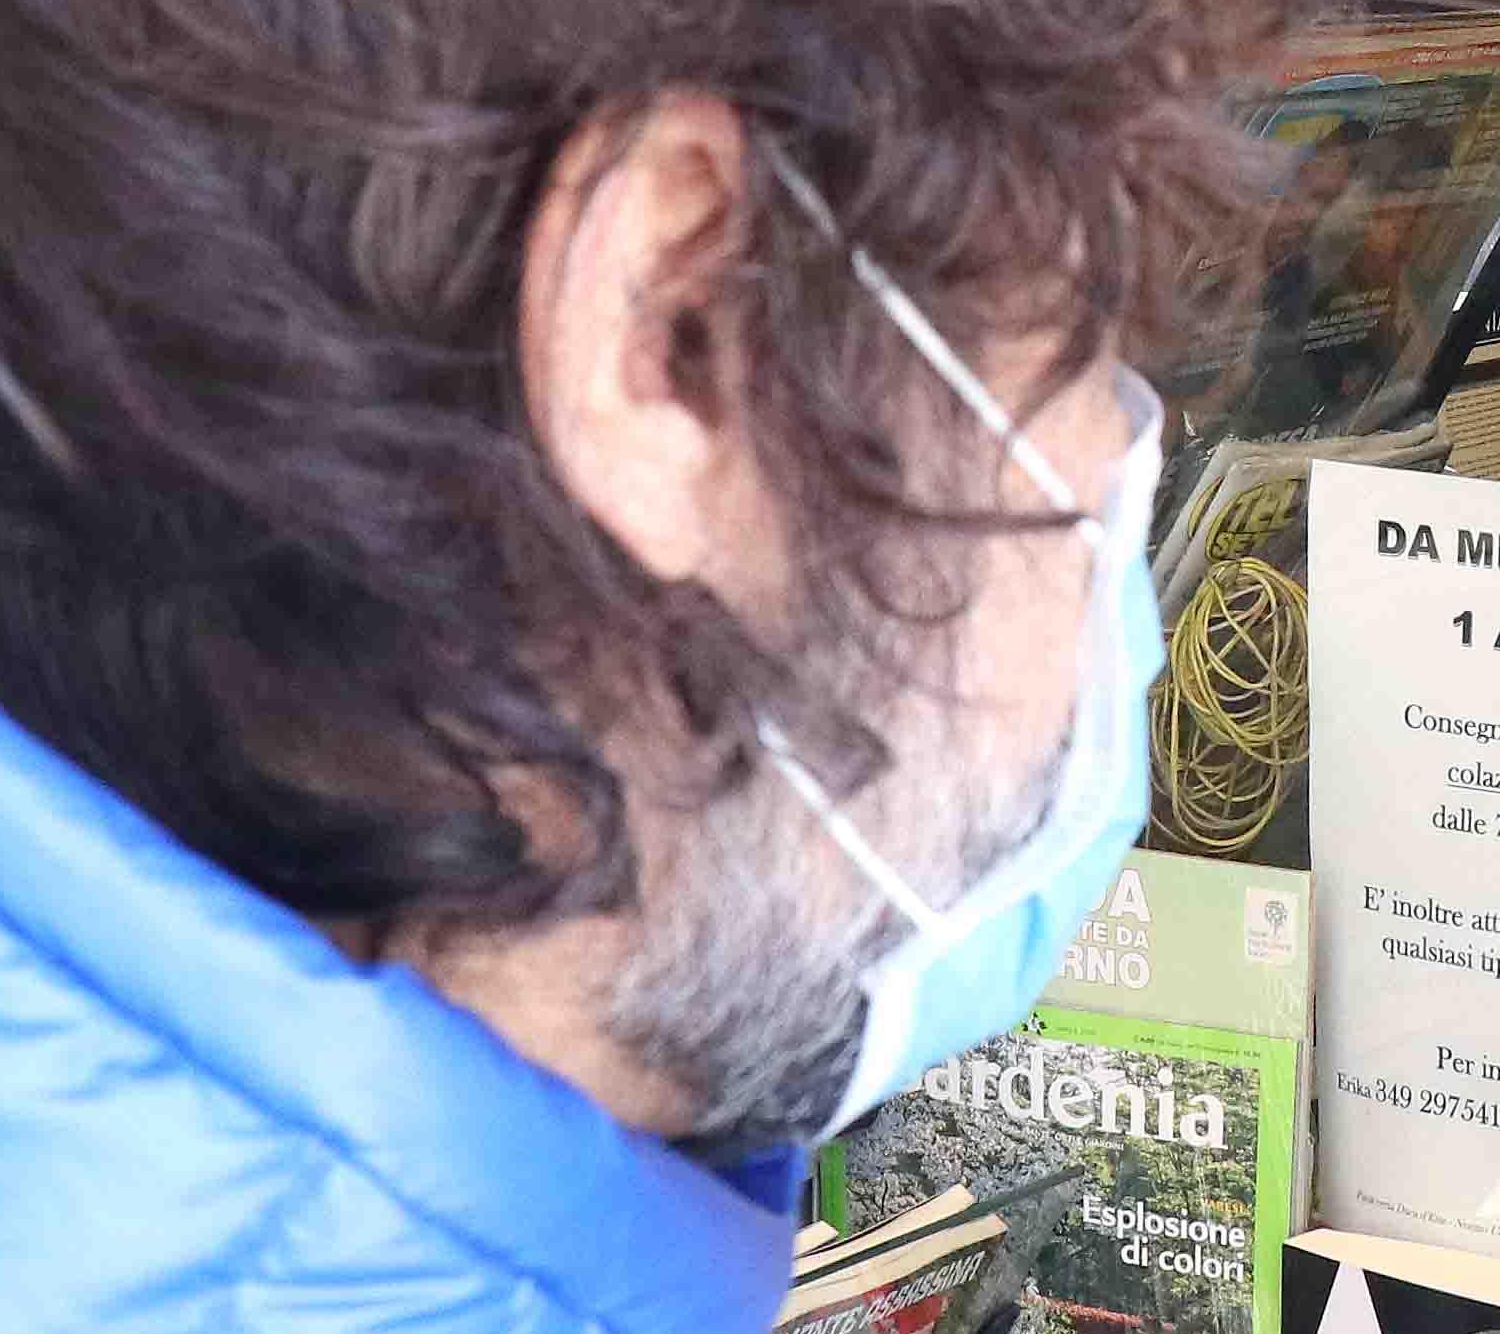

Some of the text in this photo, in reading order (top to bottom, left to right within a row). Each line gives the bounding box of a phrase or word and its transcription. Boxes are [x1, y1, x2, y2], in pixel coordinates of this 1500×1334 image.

[1377, 520, 1440, 561] DA
[1453, 611, 1474, 648] 1
[1432, 805, 1488, 840] dalle
[1363, 886, 1386, 913] E'
[1392, 892, 1464, 926] inoltre
[1381, 933, 1475, 972] qualsiasi
[1436, 1047, 1476, 1077] Per
[1336, 1072, 1372, 1101] Erika
[1374, 1079, 1414, 1112] 349
[1083, 1195, 1246, 1249] Esplosione
[1120, 1240, 1246, 1283] di colori
